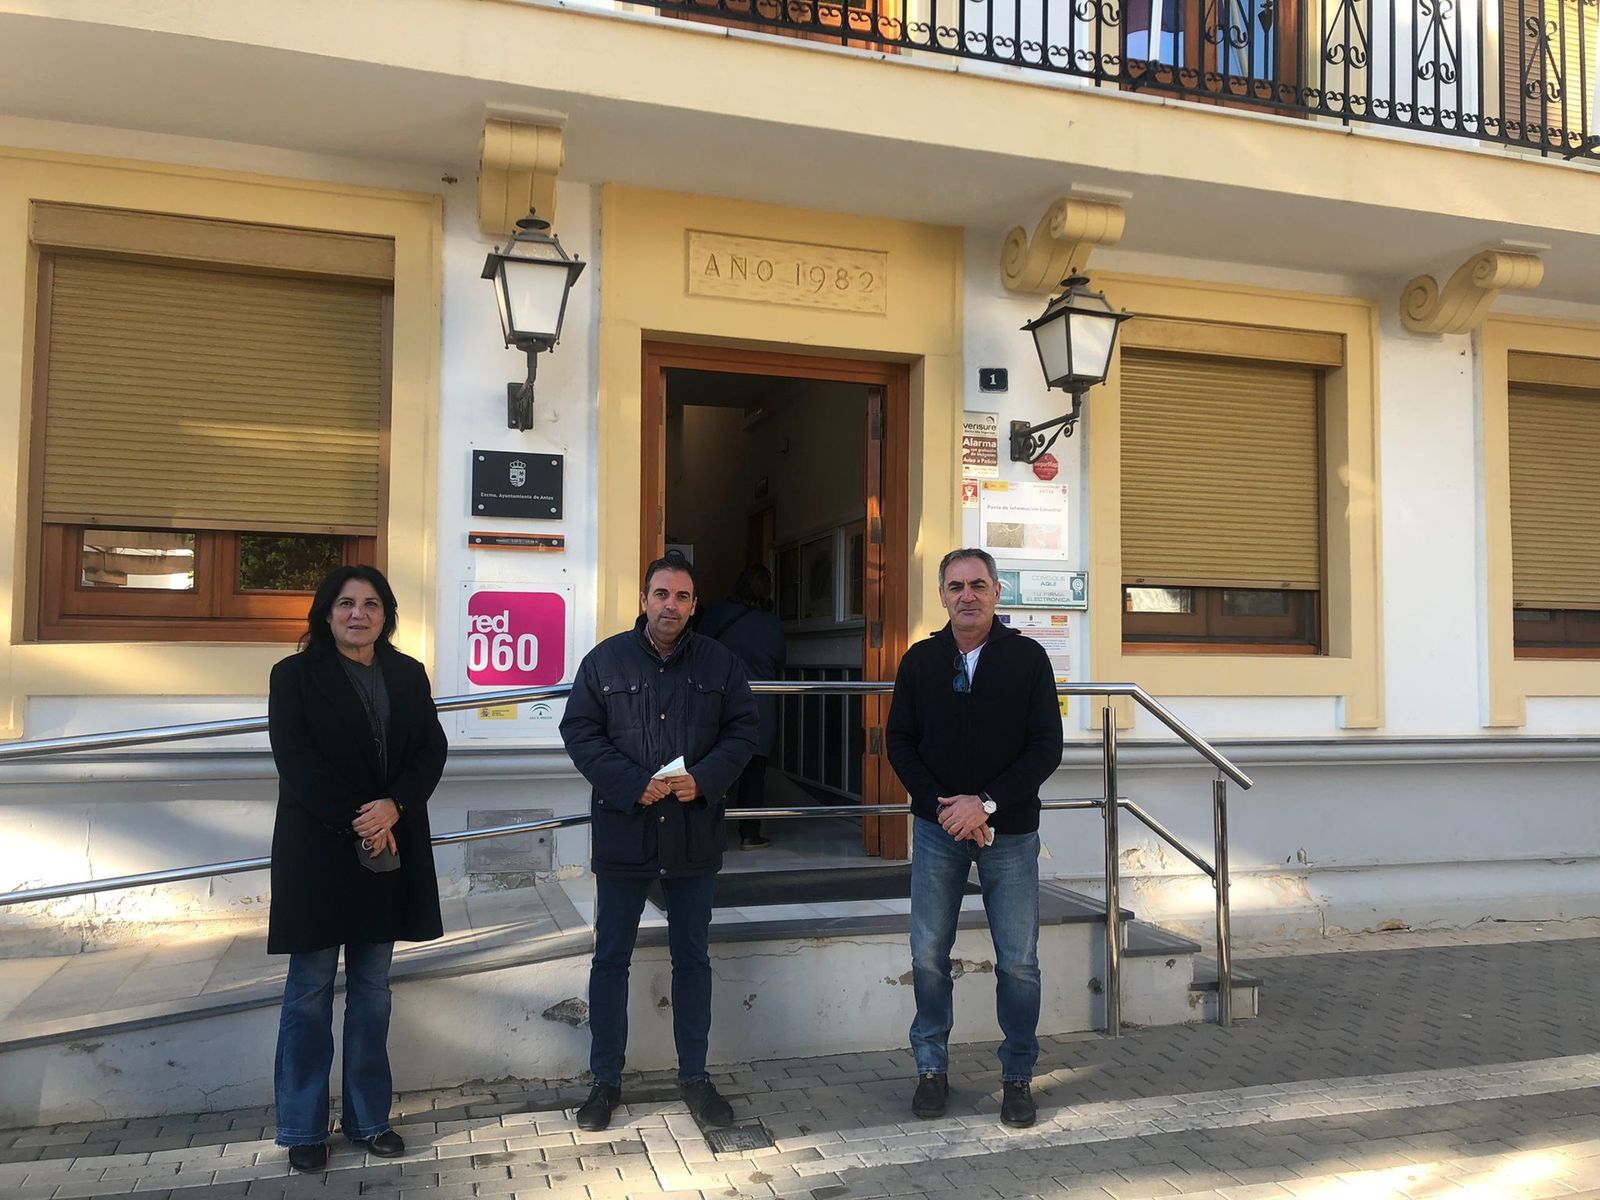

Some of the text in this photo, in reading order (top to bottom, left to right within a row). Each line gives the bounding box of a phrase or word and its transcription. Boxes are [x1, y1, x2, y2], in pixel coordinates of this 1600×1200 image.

[704, 253, 875, 294] AÑO 1982
[989, 373, 997, 385] 1
[962, 422, 997, 431] verisure
[962, 437, 997, 448] Alarma
[468, 610, 509, 633] red
[468, 633, 539, 672] 060
